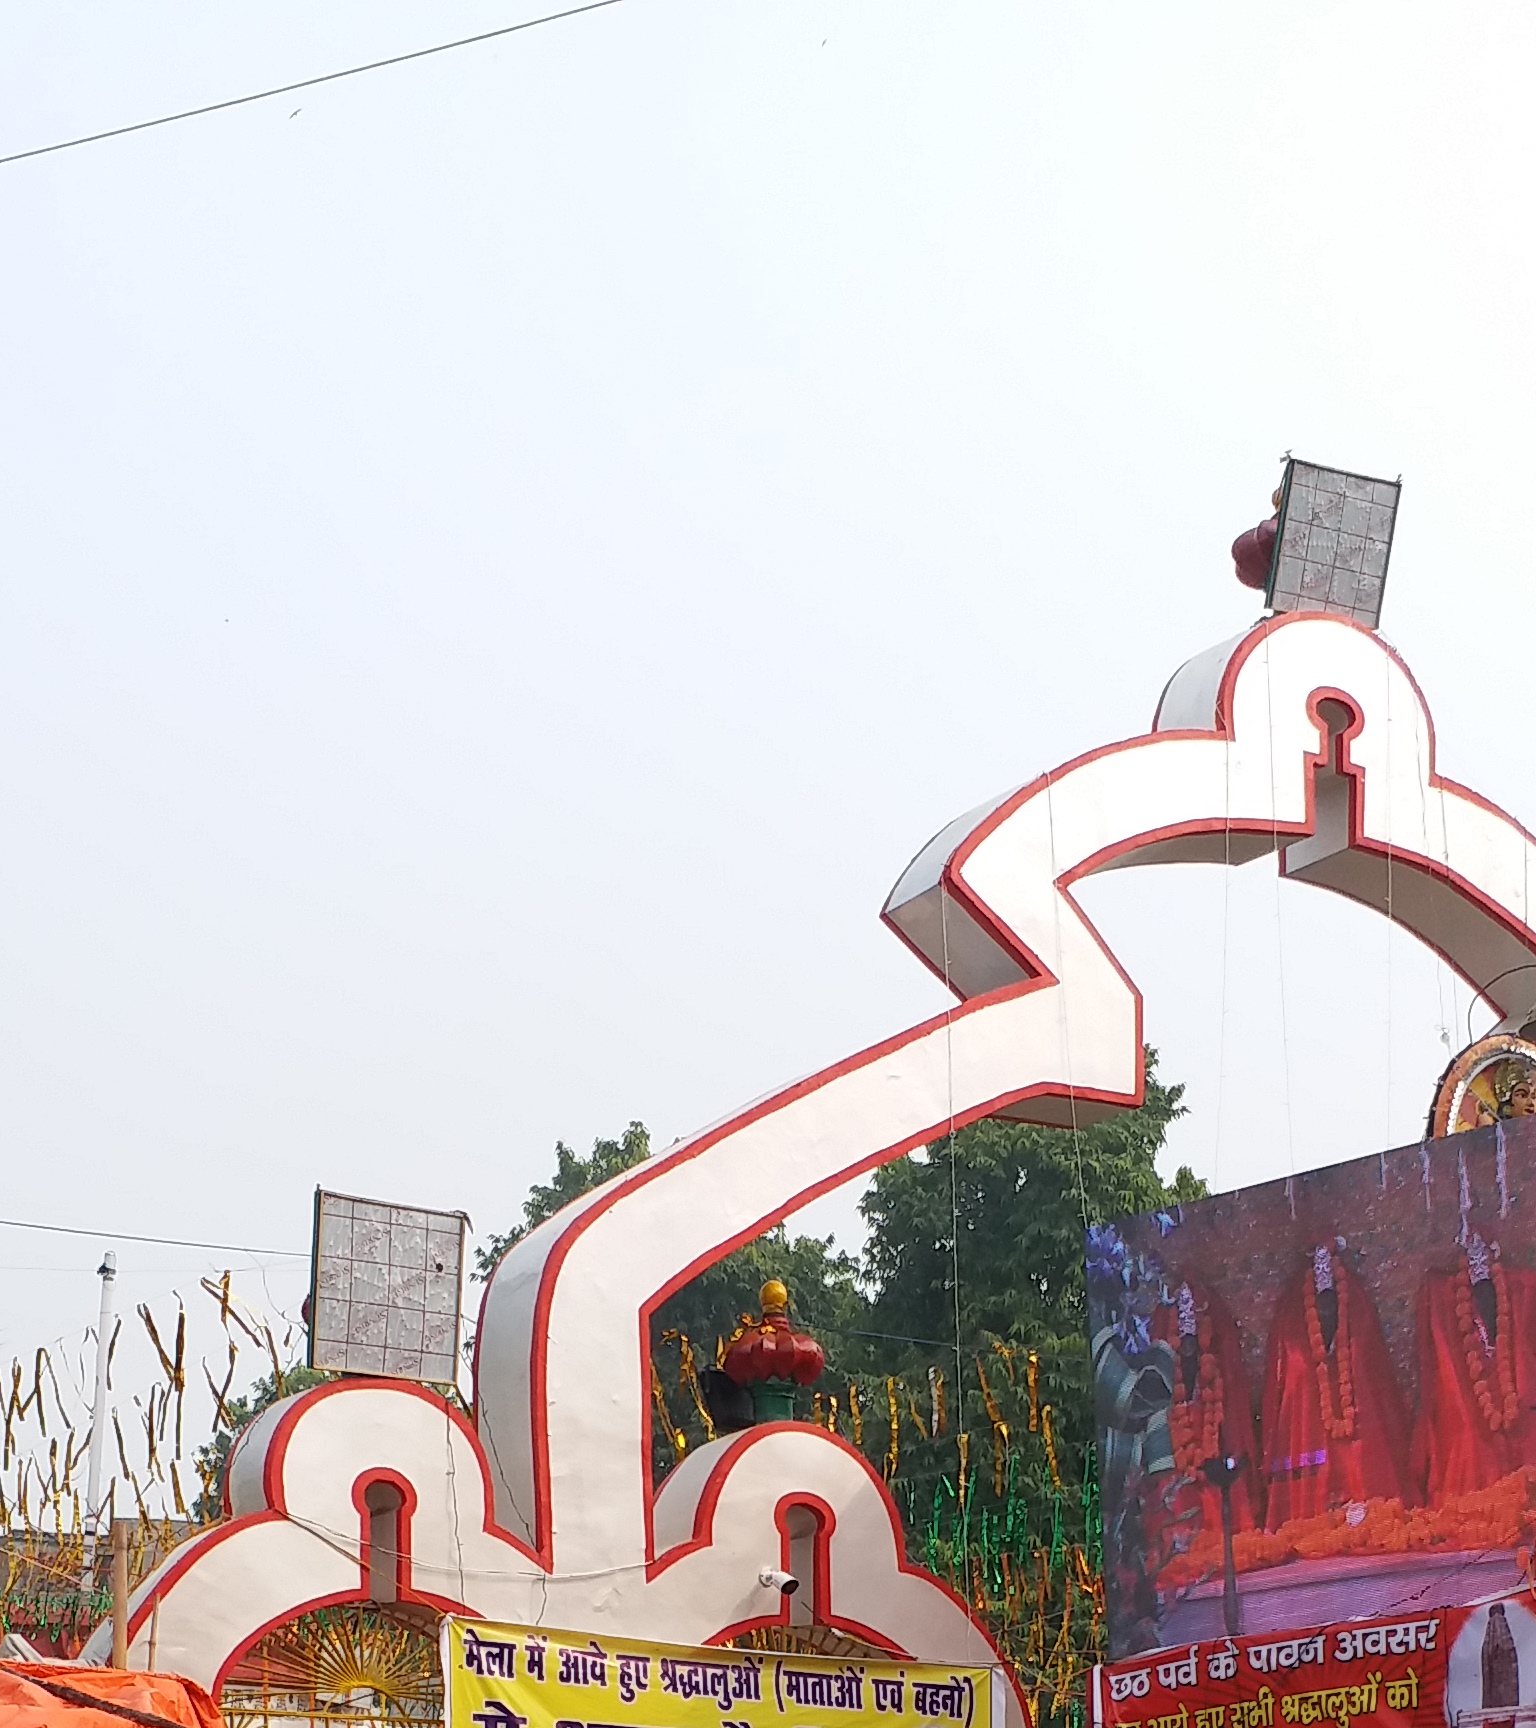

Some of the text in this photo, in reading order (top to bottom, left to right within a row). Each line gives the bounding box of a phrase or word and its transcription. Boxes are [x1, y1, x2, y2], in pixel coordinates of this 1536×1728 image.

[464, 1629, 516, 1678] मेला
[525, 1635, 547, 1681] में
[559, 1641, 607, 1686] आये
[616, 1655, 650, 1702] हुए
[661, 1657, 763, 1710] श्रद्धालुओं
[872, 1672, 904, 1713] एवं
[1109, 1619, 1440, 1701] छठ पर्व के पावन अवसर
[1385, 1667, 1418, 1709] को
